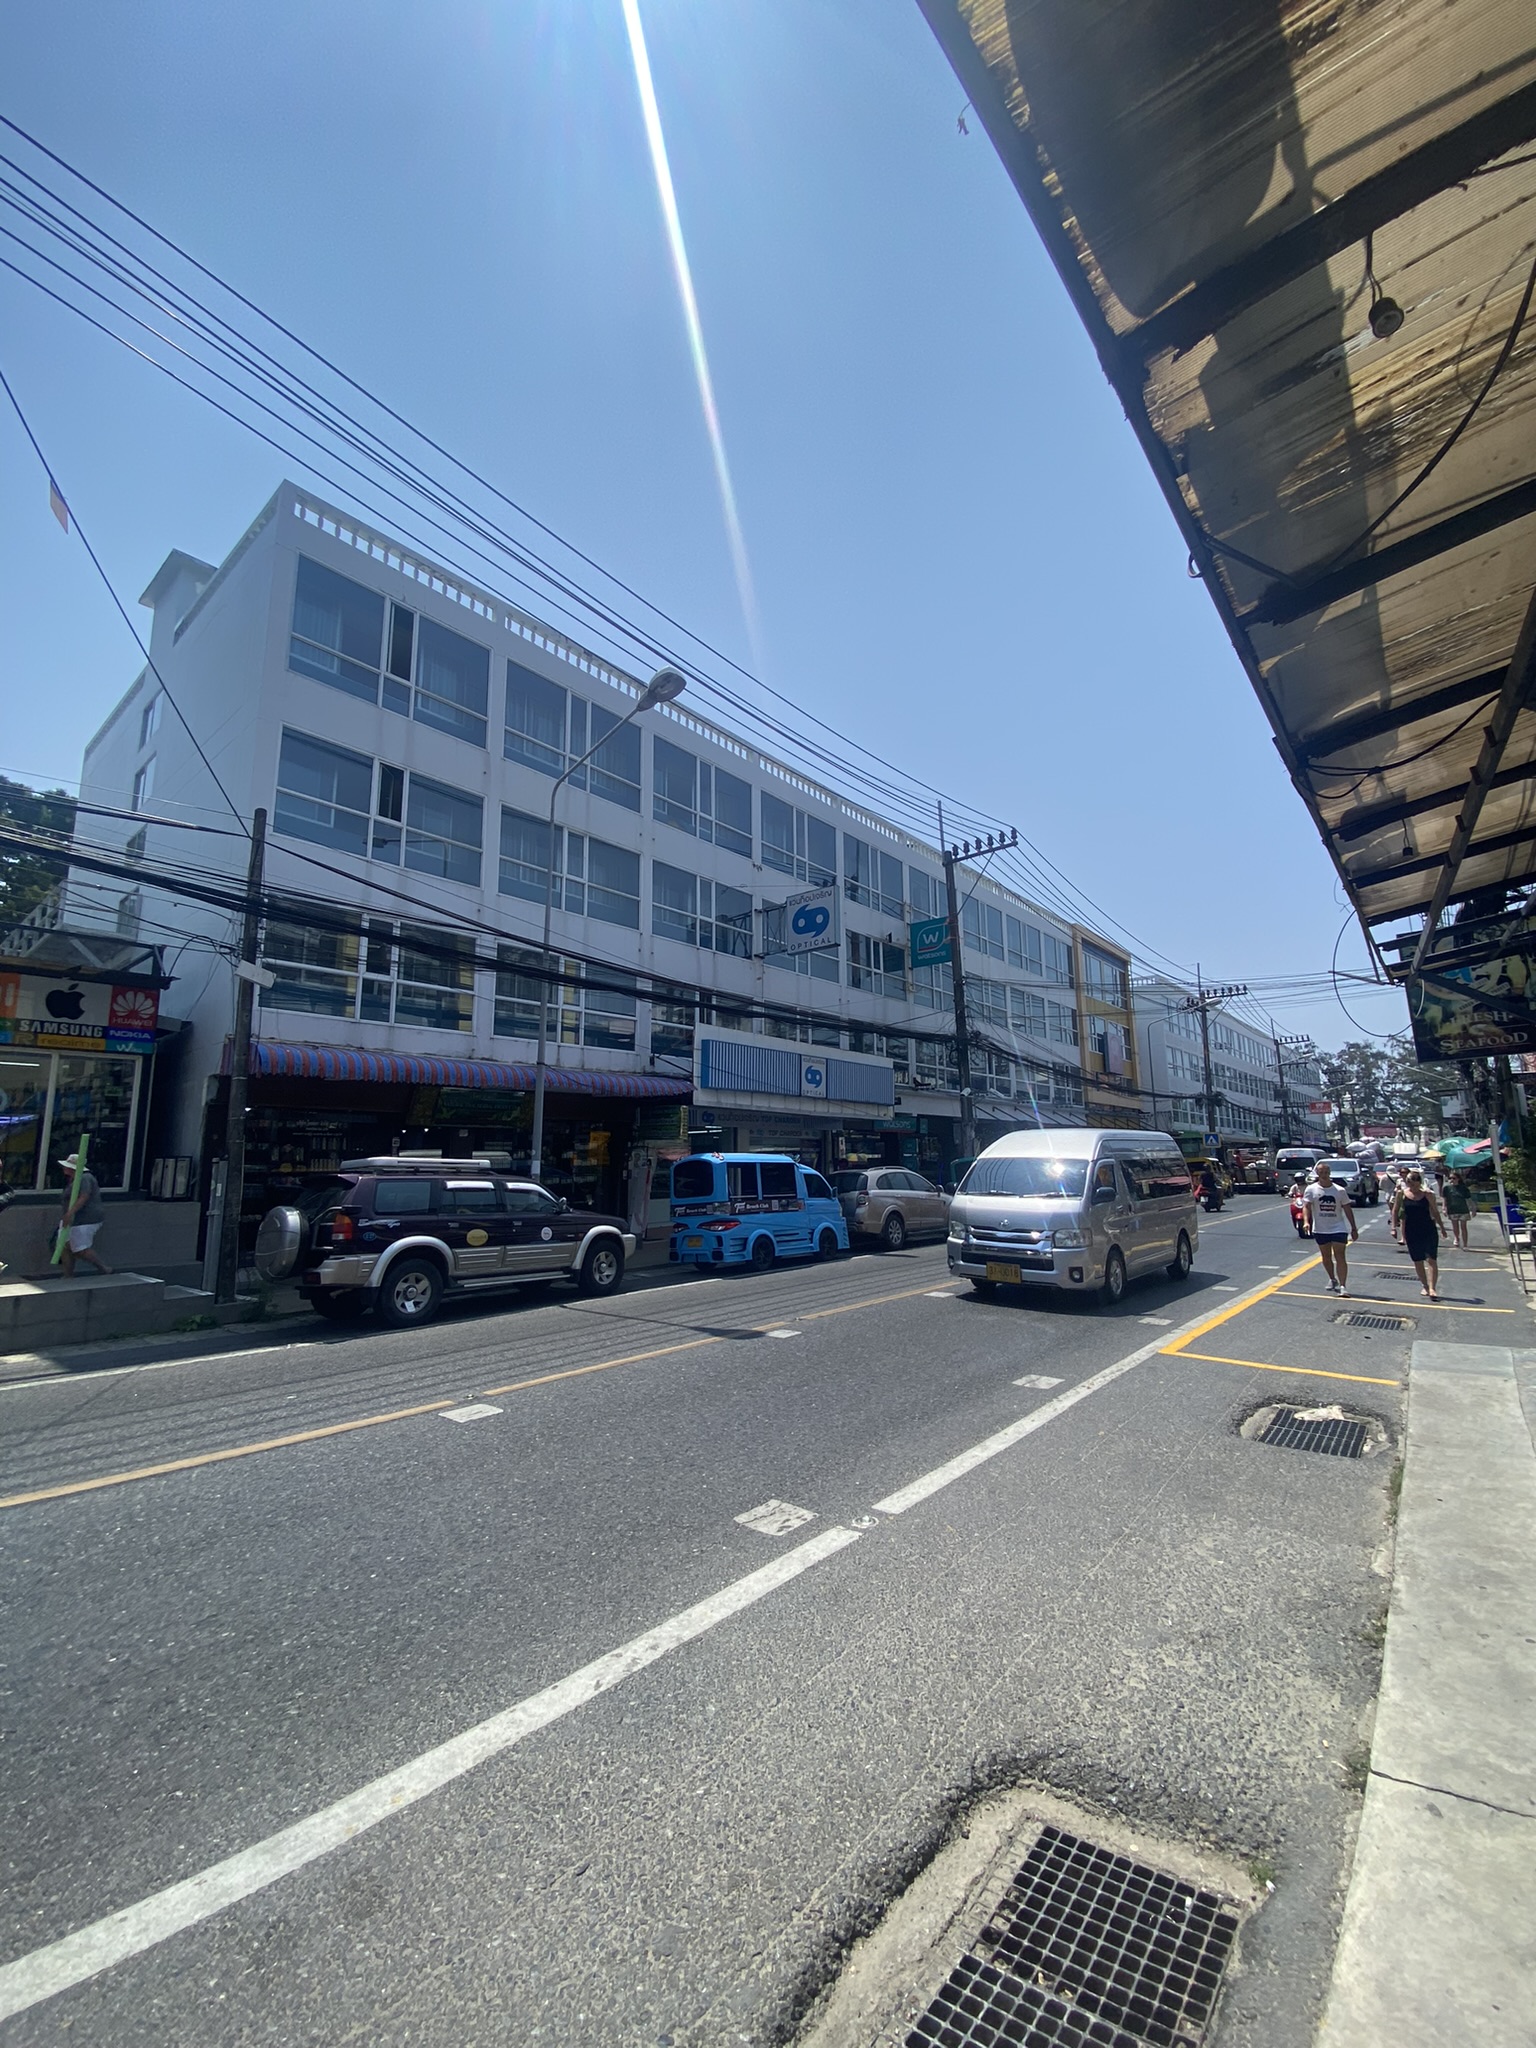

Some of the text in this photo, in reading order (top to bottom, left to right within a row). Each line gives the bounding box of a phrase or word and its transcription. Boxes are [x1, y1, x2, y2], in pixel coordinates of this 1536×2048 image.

[790, 937, 832, 951] OPTICAL
[19, 1020, 103, 1038] SAMSUNG
[112, 1017, 153, 1028] HUAWEI
[109, 1029, 151, 1040] NOKIA
[1440, 1031, 1528, 1051] SEAFOOD
[40, 1036, 102, 1048] realme
